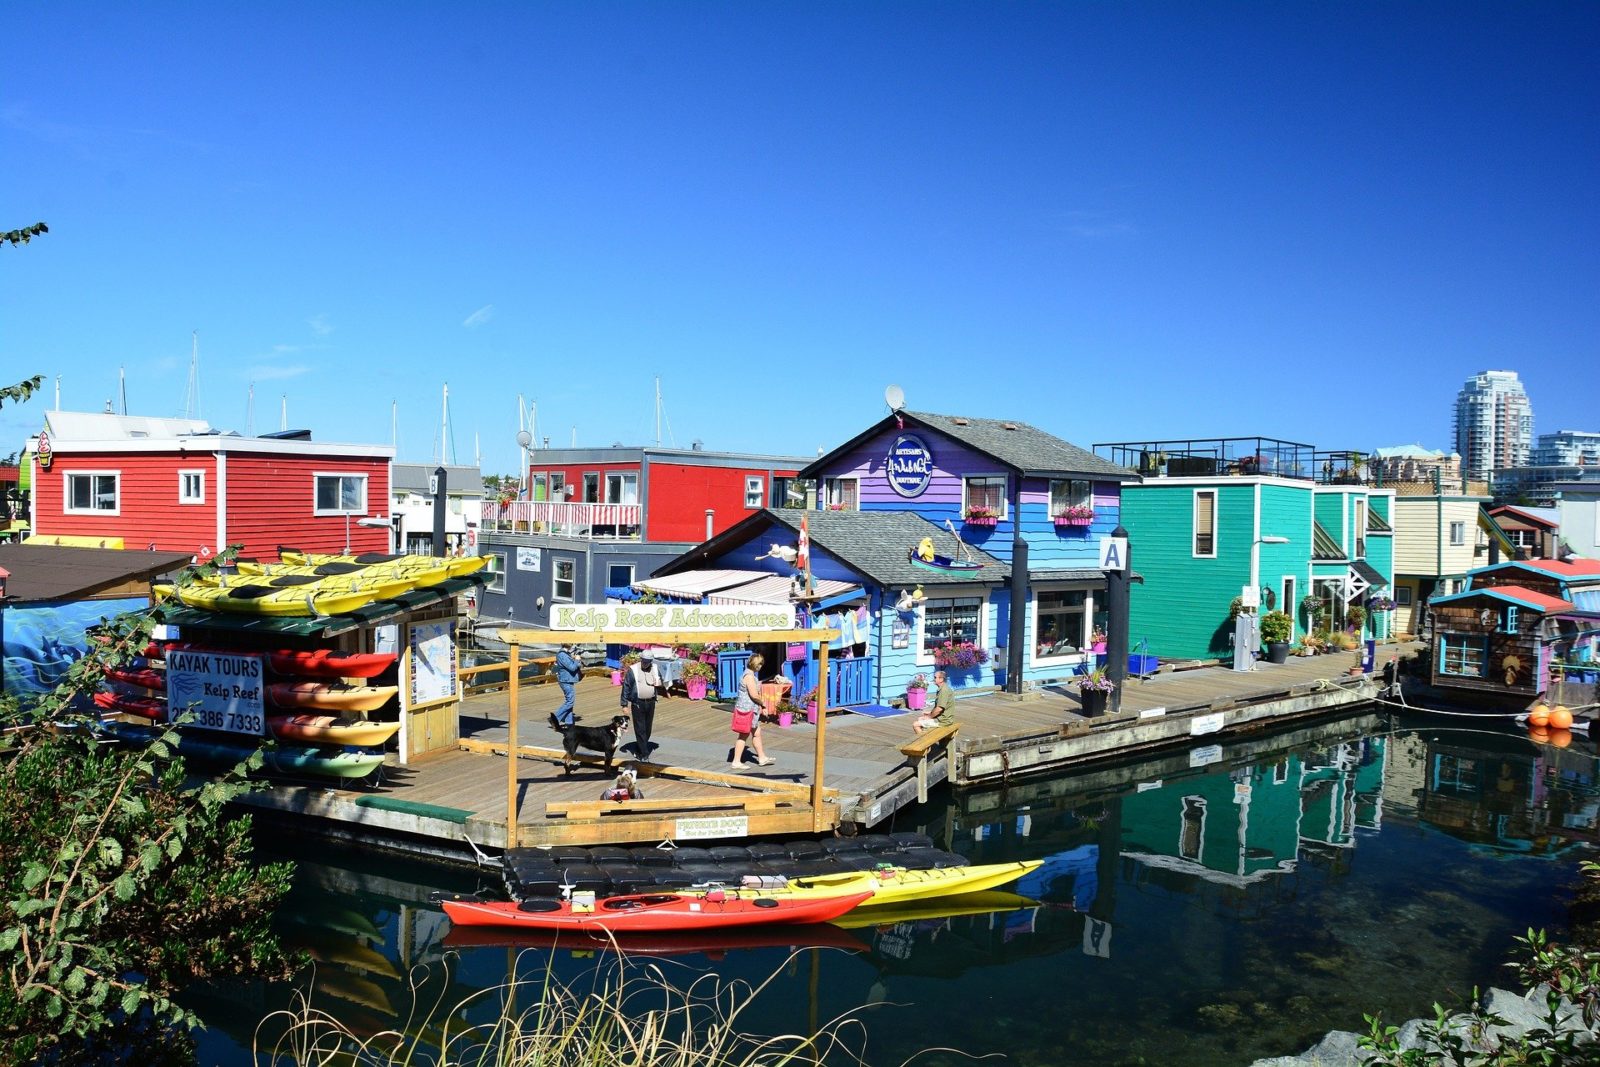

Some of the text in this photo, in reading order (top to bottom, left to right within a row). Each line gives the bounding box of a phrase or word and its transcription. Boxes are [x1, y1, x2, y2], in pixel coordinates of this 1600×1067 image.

[431, 479, 436, 492] B
[1104, 543, 1121, 567] A
[557, 607, 789, 633] Kelp Reef Adventures
[170, 654, 259, 677] KAYAK TOURS
[203, 682, 260, 701] Kelp Reef
[199, 710, 224, 728] 386
[228, 713, 261, 733] 7333
[677, 818, 747, 830] PRIVATE DOCK
